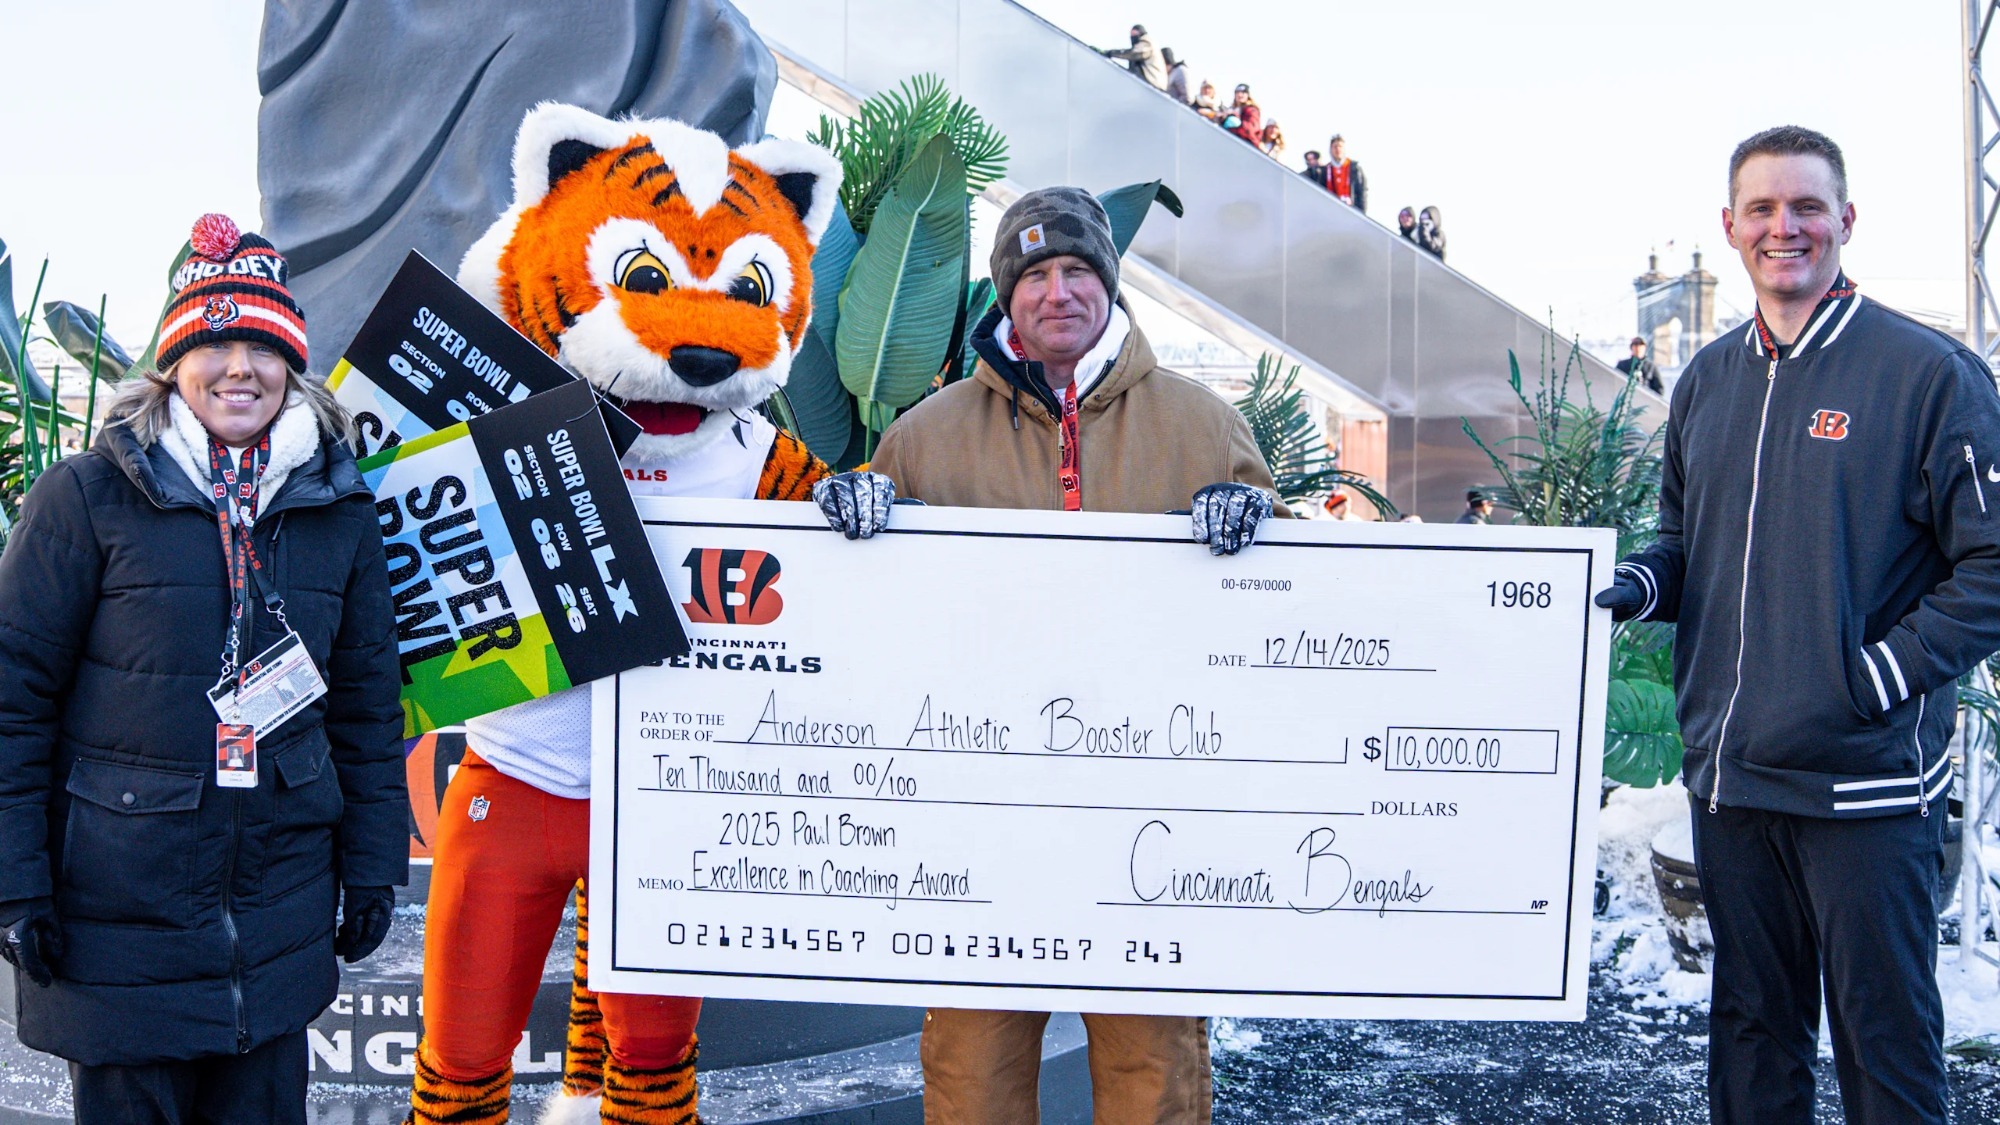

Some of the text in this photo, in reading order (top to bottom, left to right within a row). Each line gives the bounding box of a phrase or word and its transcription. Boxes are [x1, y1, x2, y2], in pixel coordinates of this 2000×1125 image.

[173, 255, 283, 291] WHO DEY
[401, 340, 447, 381] SECTION
[413, 306, 468, 360] SUPER
[463, 345, 512, 396] BOWL
[388, 353, 434, 395] 02
[446, 399, 478, 422] 0
[465, 391, 493, 414] ROW
[503, 448, 534, 501] 02
[524, 444, 550, 498] SECTION
[530, 517, 561, 570] 08
[546, 428, 639, 624] SUPER BOWL LX
[554, 522, 573, 552] ROW
[405, 475, 523, 662] SUPER
[1221, 578, 1292, 592] 00-679/0000
[375, 496, 459, 686] BOWL
[554, 582, 587, 634] 26
[579, 587, 599, 617] SEAT
[1486, 580, 1552, 609] 1968
[689, 638, 787, 650] INCINNATI
[1208, 654, 1246, 667] DATE
[1265, 631, 1390, 667] 12/14/2025
[643, 652, 822, 674] ENGALS
[640, 711, 725, 726] PAY TO THE
[640, 728, 714, 742] ORDER OF
[747, 689, 1222, 757] Anderson Athletic Booster Club
[1362, 736, 1382, 763] $
[1396, 735, 1501, 769] 10,000.00
[652, 754, 917, 797] Ten Thousand and 00/100
[1371, 801, 1458, 817] DOLLARS
[718, 810, 896, 847] 2025 Paul Brown
[638, 877, 684, 891] MEMO
[693, 850, 970, 911] Excellence in Coaching Award
[1130, 820, 1436, 919] Cincinnati Bengals
[667, 922, 1183, 964] 021234567 001234567 243
